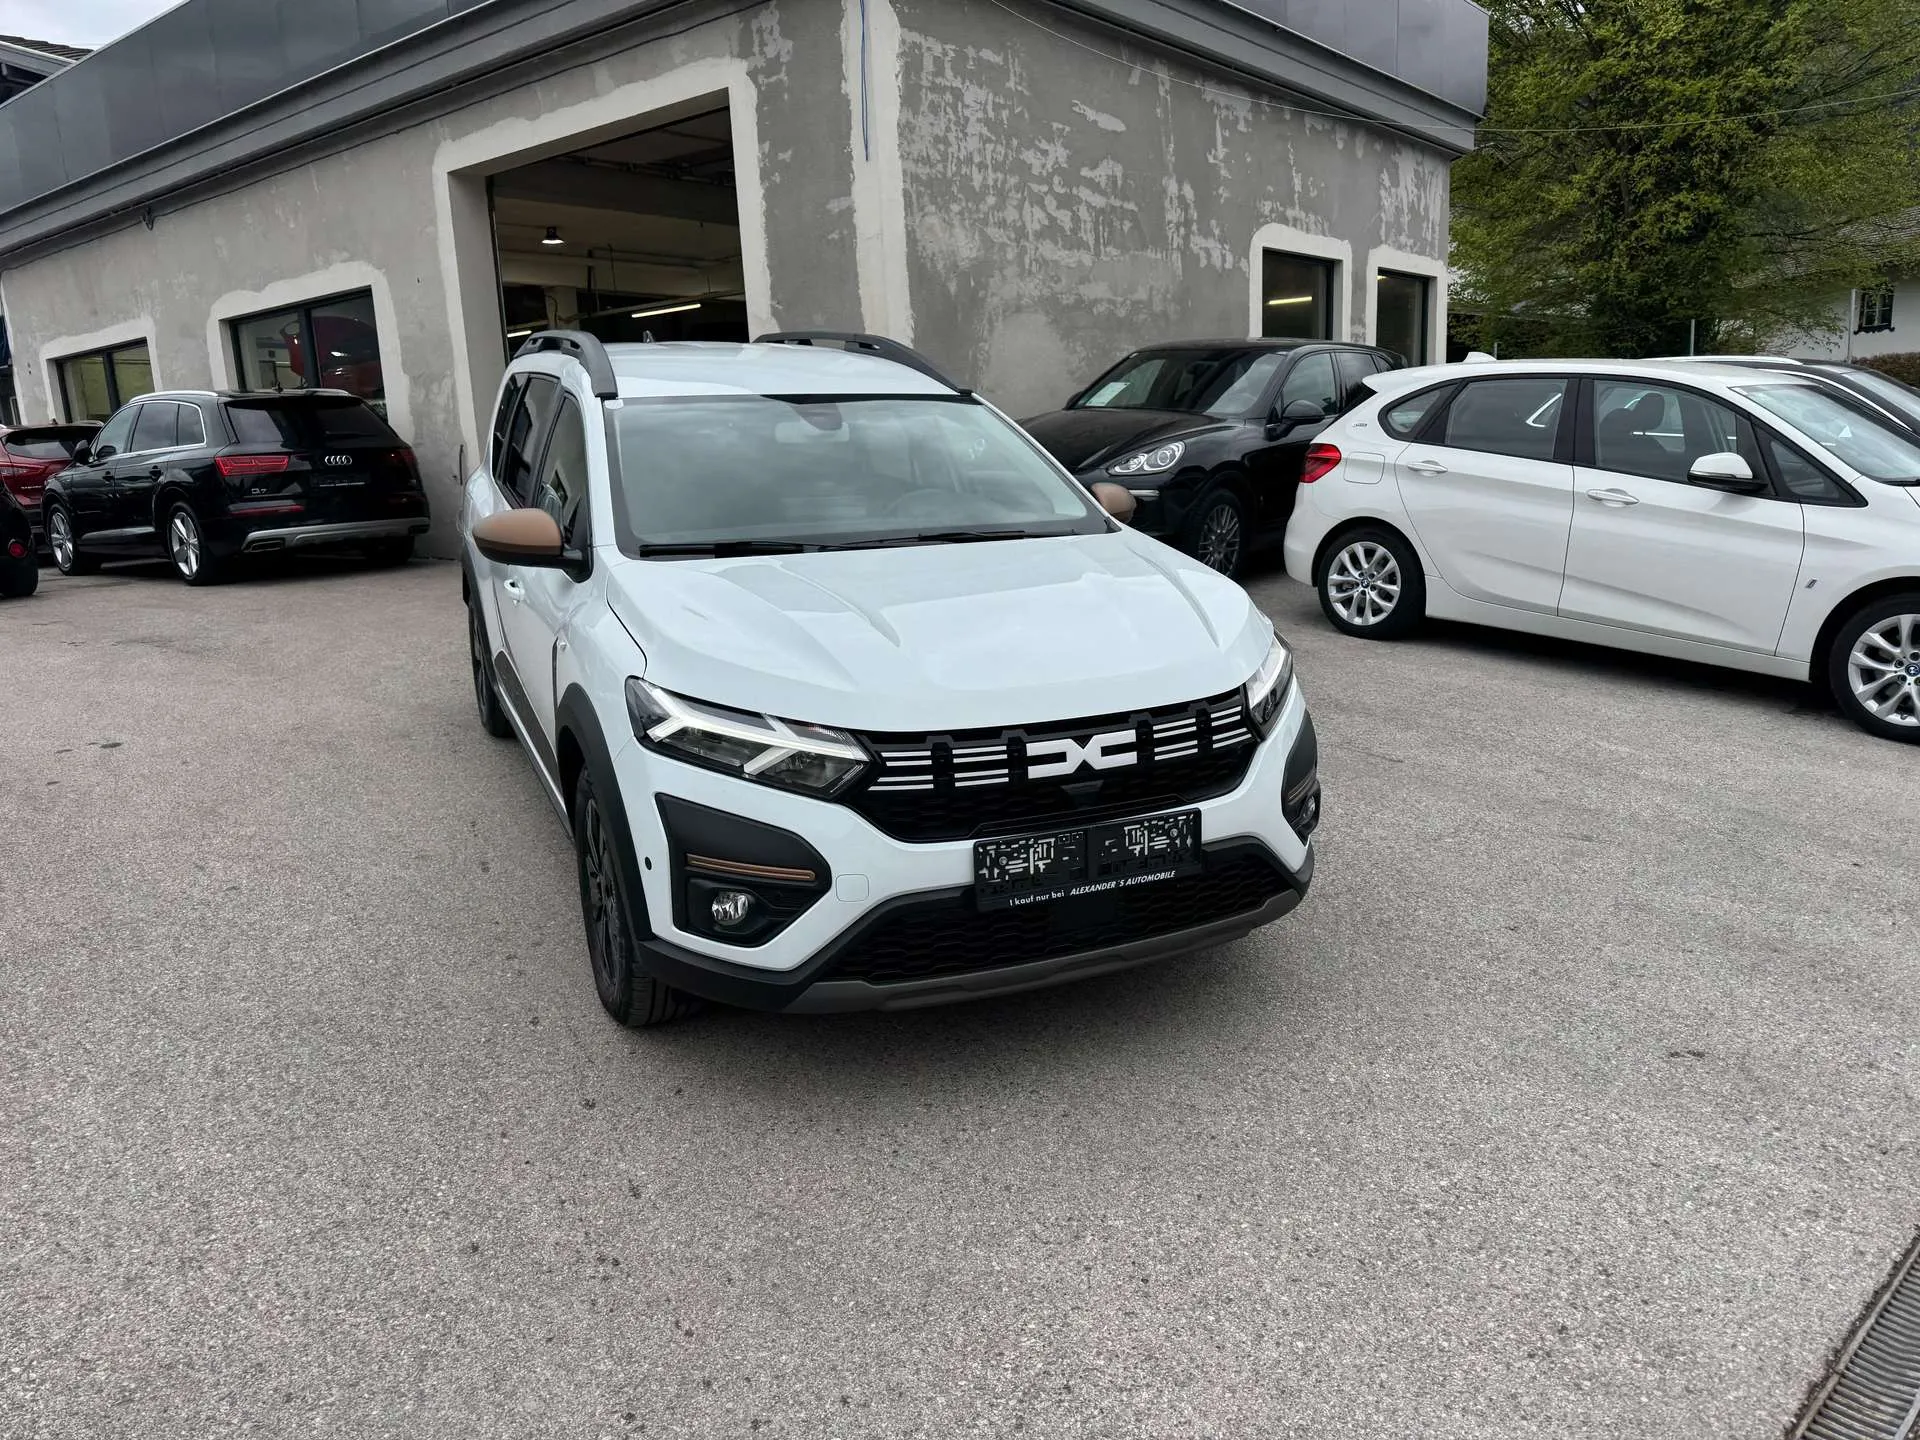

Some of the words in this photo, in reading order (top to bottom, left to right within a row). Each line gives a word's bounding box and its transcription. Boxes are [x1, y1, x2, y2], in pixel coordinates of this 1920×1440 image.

[1014, 894, 1033, 905] kauf
[1036, 894, 1049, 902] nur
[1051, 889, 1064, 899] bei
[1069, 881, 1116, 896] ALEXANDER
[1125, 870, 1176, 886] AUTOMOBILE
